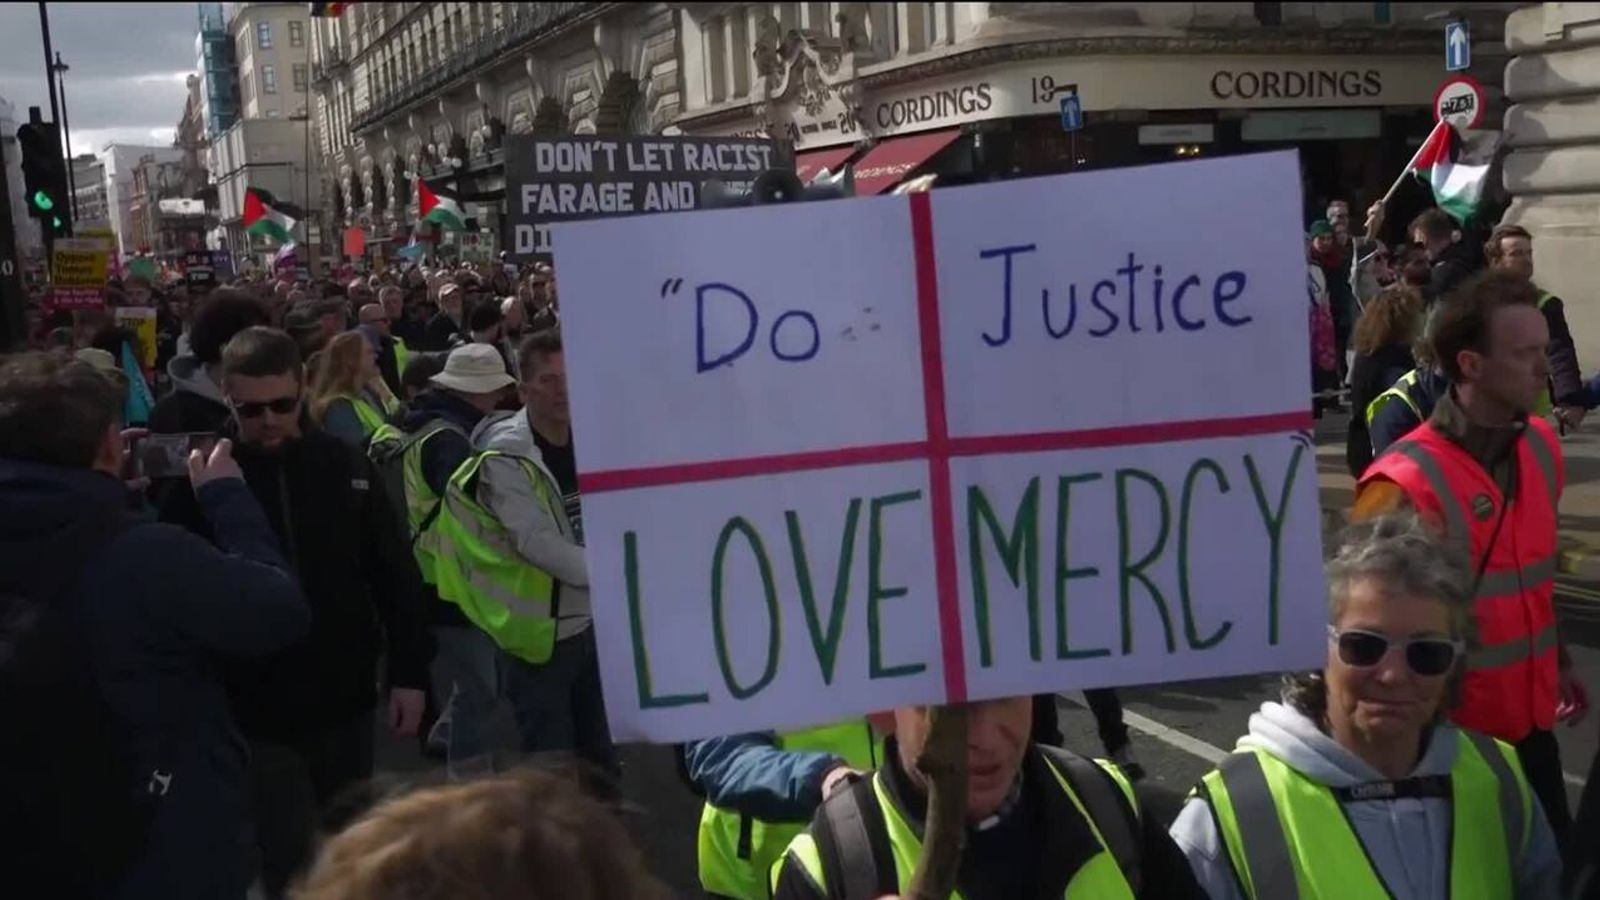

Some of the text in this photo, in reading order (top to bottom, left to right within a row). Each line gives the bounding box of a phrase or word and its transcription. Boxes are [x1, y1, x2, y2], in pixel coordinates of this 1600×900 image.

[1032, 75, 1054, 103] 19
[1210, 70, 1382, 99] CORDINGS
[877, 82, 991, 128] CORDINGS
[536, 141, 771, 173] DON'T LET RACIST
[521, 182, 634, 214] FARAGE
[643, 181, 695, 211] AND
[514, 223, 552, 254] DI
[979, 243, 1253, 347] Justice
[623, 489, 927, 710] LOVE
